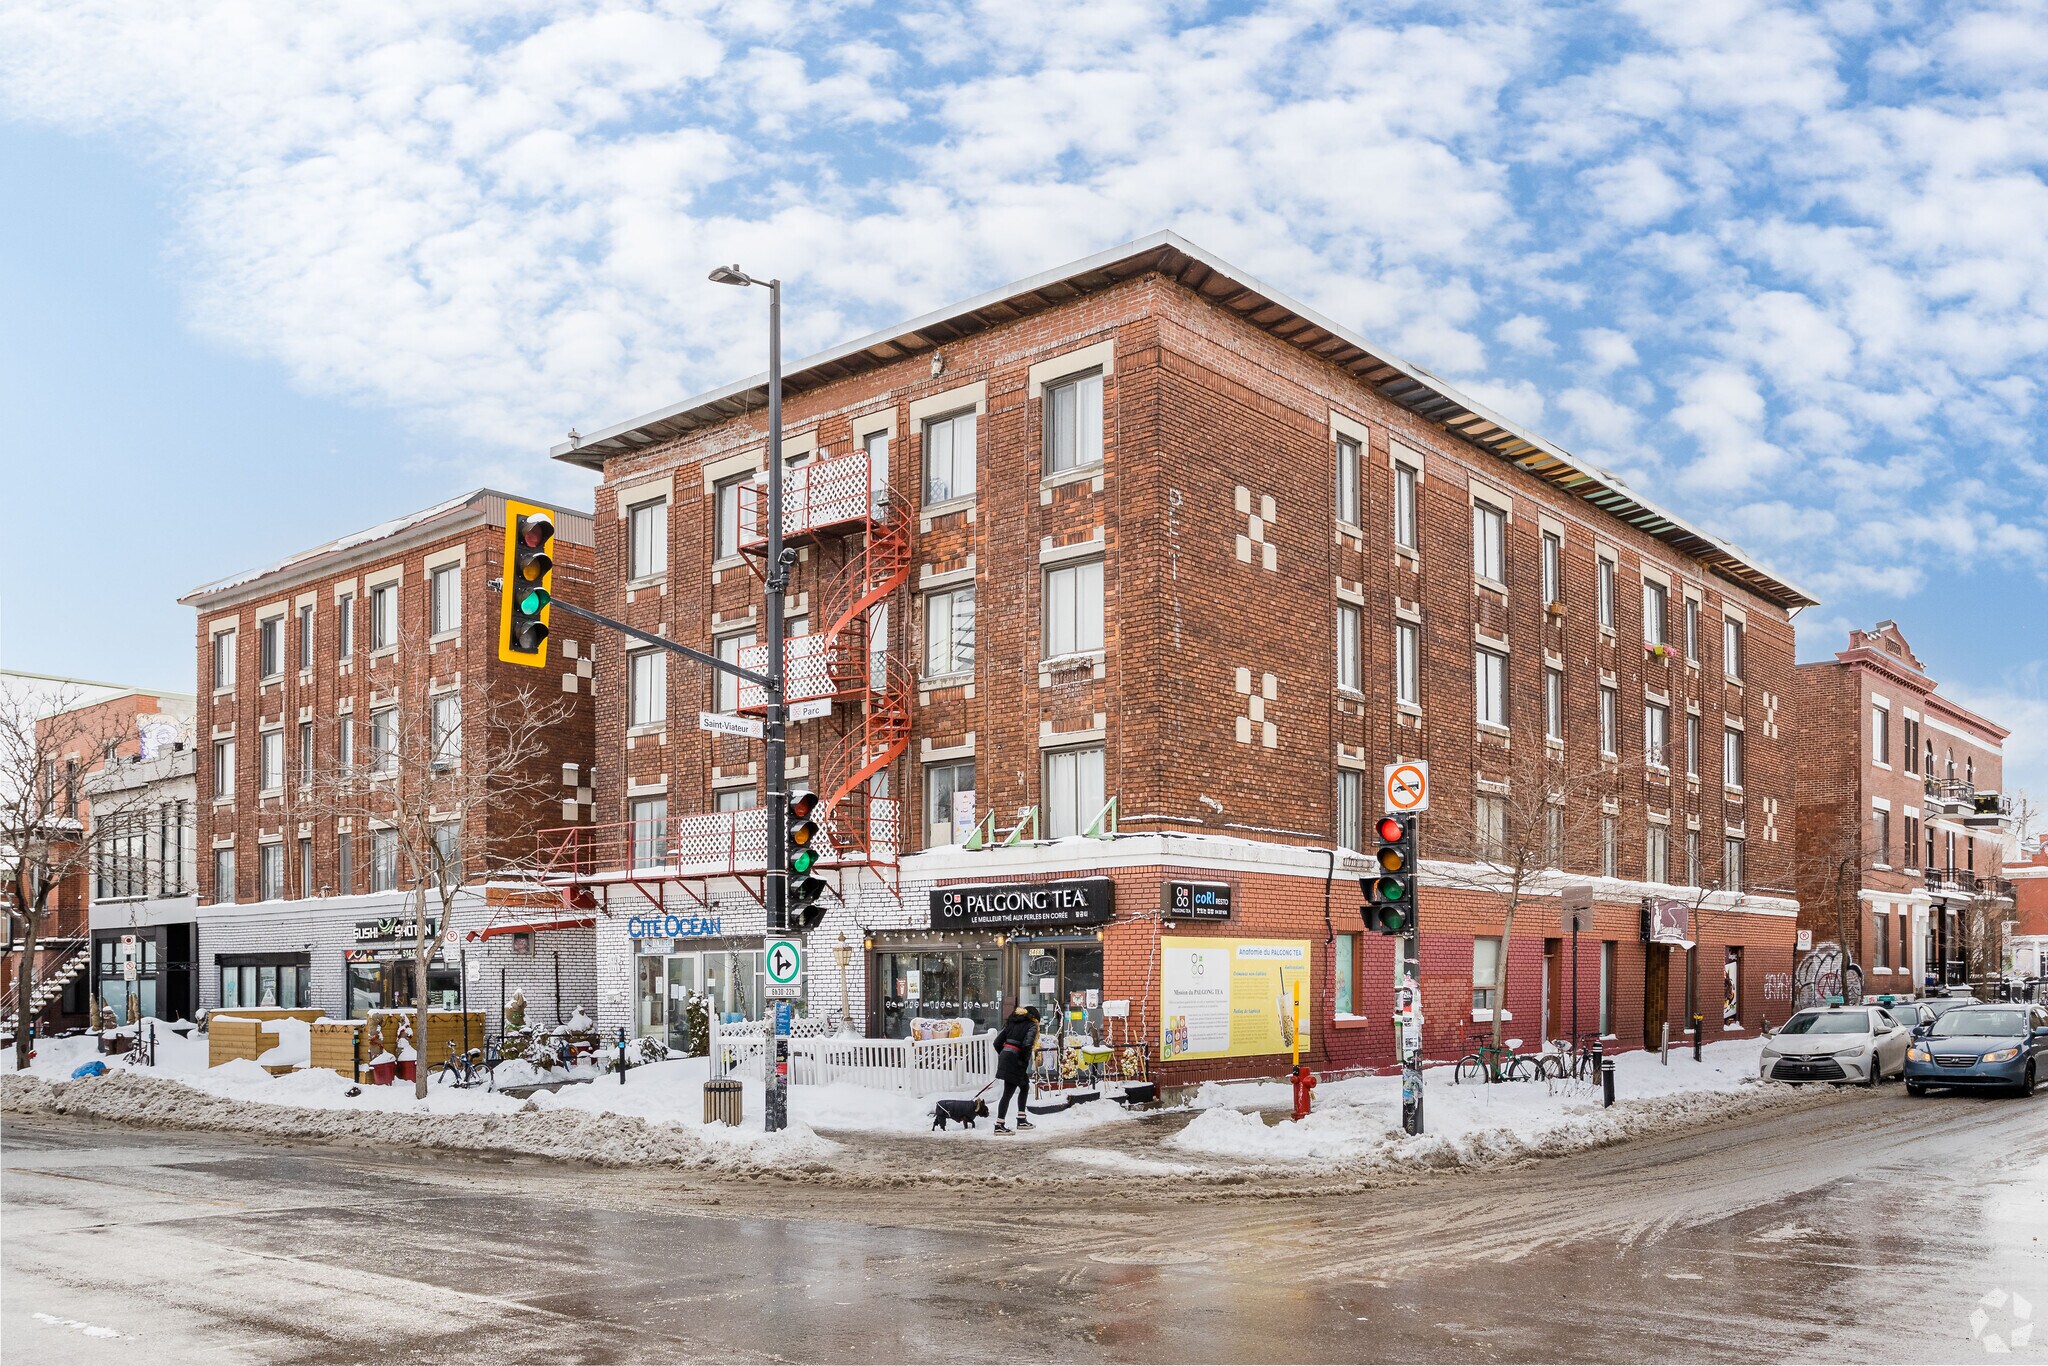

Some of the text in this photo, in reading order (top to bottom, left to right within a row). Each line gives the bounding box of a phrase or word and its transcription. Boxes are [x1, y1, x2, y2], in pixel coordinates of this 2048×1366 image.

[704, 718, 749, 732] Saint-Viateur
[967, 892, 1046, 913] PALGONG
[1052, 890, 1084, 908] TEA
[353, 927, 378, 939] SUSHI
[628, 915, 662, 937] CITÉ
